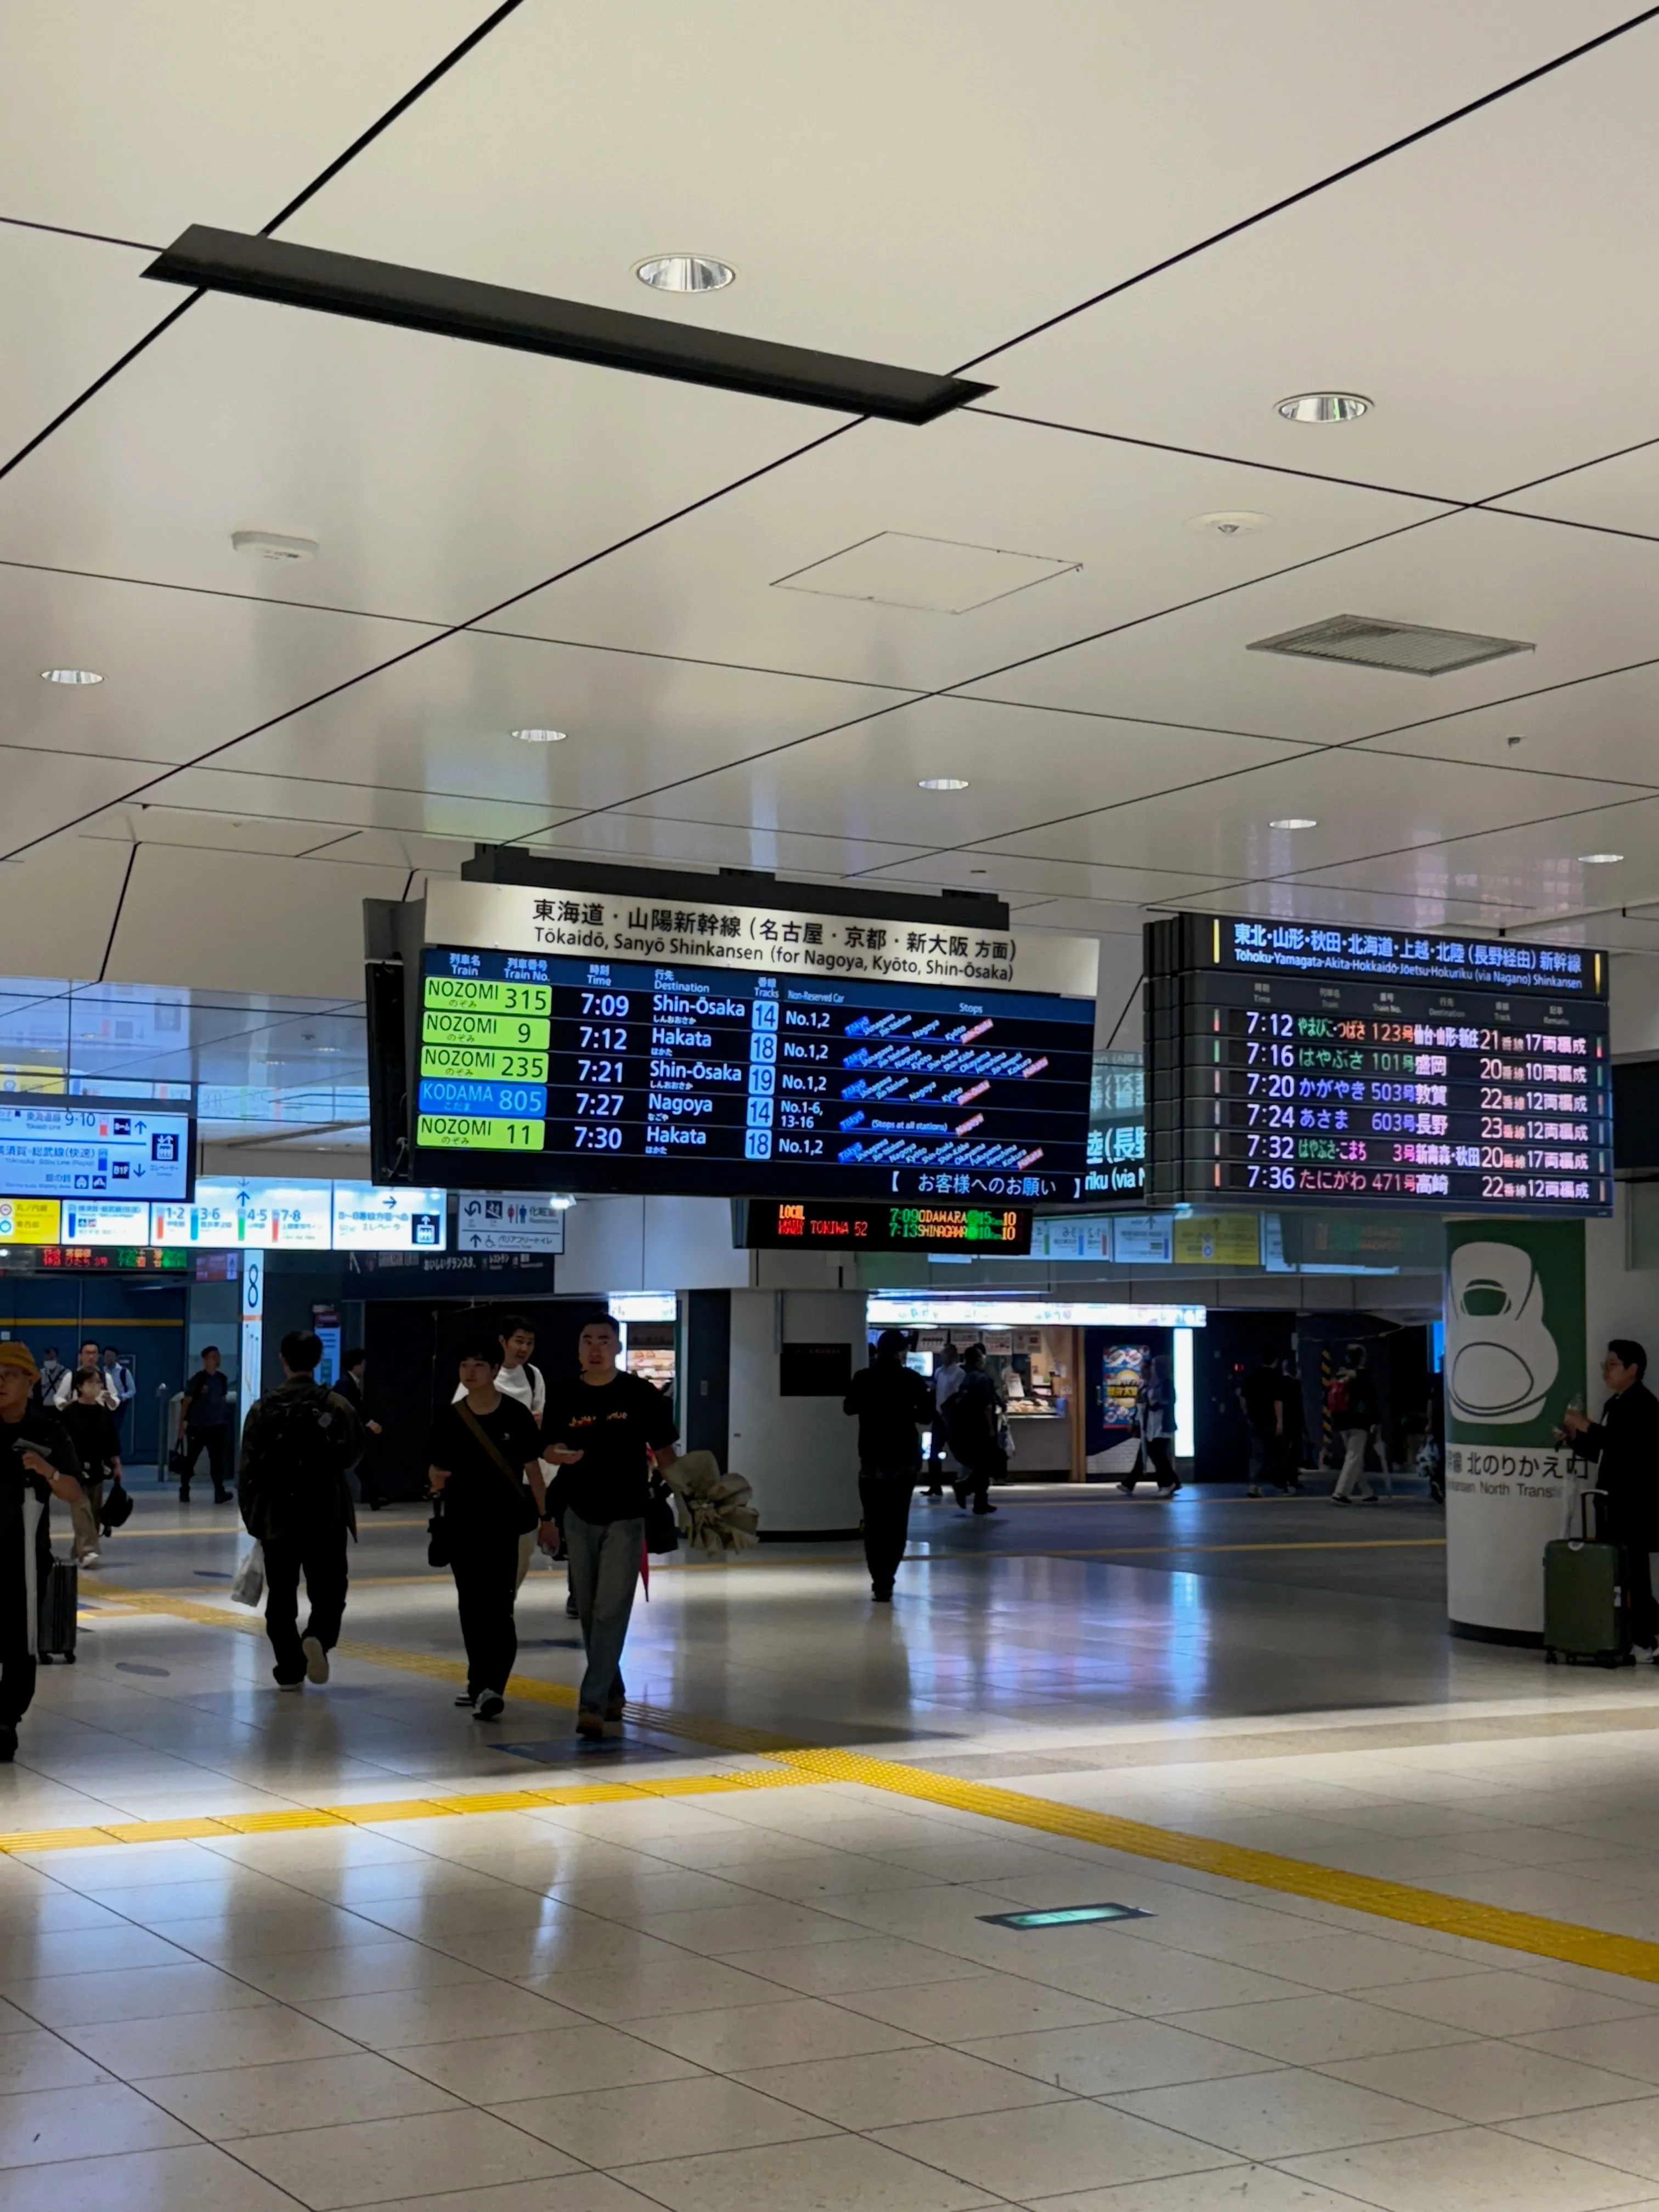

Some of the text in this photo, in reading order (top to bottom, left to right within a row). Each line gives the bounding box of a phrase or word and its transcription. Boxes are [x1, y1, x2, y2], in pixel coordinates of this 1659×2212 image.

[535, 927, 1013, 982] Tōkaidō, Sanyō Shinkansen (for Nagoya, Kyōto, Shin-Ōsaka)
[449, 953, 480, 966] 列車名
[654, 969, 674, 981] 行先
[1475, 968, 1491, 982] (via
[1494, 970, 1531, 986] Nagano)
[1533, 974, 1582, 988] Shinkansen
[452, 965, 478, 976] Train
[504, 968, 530, 980] Train
[533, 972, 550, 981] No.
[587, 975, 612, 986] Time
[654, 980, 709, 993] Destination
[754, 987, 779, 998] Tracks
[959, 1002, 983, 1015] Stops
[428, 980, 498, 1000] NOZOMI
[505, 989, 546, 1010] 315
[581, 992, 629, 1017] 7:09
[653, 994, 745, 1017] Shin-Ōsaka
[755, 1004, 776, 1028] 14
[786, 1011, 830, 1029] No.1,2
[449, 1000, 477, 1008] のぞみ
[1246, 1012, 1293, 1036] 7:12
[427, 1014, 496, 1034] NOZOMI
[518, 1023, 531, 1043] 9
[579, 1026, 627, 1050] 7:12
[652, 1028, 712, 1047] Hakata
[753, 1036, 774, 1059] 18
[784, 1042, 828, 1060] No.1,2
[447, 1034, 475, 1042] のぞみ
[1246, 1042, 1294, 1067] 7:16
[1299, 1048, 1363, 1070] はやぶさ
[425, 1048, 494, 1068] NOZOMI
[501, 1056, 543, 1077] 235
[578, 1059, 623, 1083] 7:21
[650, 1059, 742, 1081] Shin-Ōsaka
[752, 1069, 772, 1091] 19
[782, 1074, 827, 1092] No.1,2
[445, 1068, 473, 1076] のぞみ
[1247, 1073, 1294, 1097] 7:20
[1299, 1077, 1365, 1101] かがやき
[424, 1084, 493, 1102] KODAMA
[499, 1090, 541, 1111] 805
[576, 1093, 624, 1116] 7:27
[648, 1093, 713, 1116] Nagoya
[750, 1101, 770, 1124] 14
[781, 1100, 823, 1116] No.1-6,
[444, 1102, 471, 1111] こだま
[781, 1115, 814, 1128] 13-16
[1247, 1104, 1295, 1128] 7:24
[1300, 1108, 1349, 1130] あさま
[1416, 1113, 1448, 1136] 長野
[421, 1118, 491, 1136] NOZOMI
[507, 1125, 530, 1144] 11
[574, 1126, 622, 1149] 7:30
[647, 1126, 706, 1144] Hakata
[748, 1133, 769, 1155] 18
[778, 1138, 823, 1156] No.1,2
[442, 1137, 470, 1145] のぞみ
[1247, 1135, 1294, 1159] 7:32
[918, 1173, 1056, 1196] お客様へのお願い
[1247, 1165, 1295, 1189] 7:36
[1300, 1169, 1366, 1190] たにがわ
[890, 1208, 918, 1223] 7:09
[918, 1210, 967, 1224] ODAWARA
[1003, 1211, 1017, 1226] 10
[810, 1220, 849, 1234] TOKIWA
[854, 1221, 868, 1236] 52
[890, 1223, 918, 1238] 7:13
[1002, 1227, 1015, 1240] 10
[247, 1263, 258, 1308] 8
[1480, 1482, 1510, 1496] North
